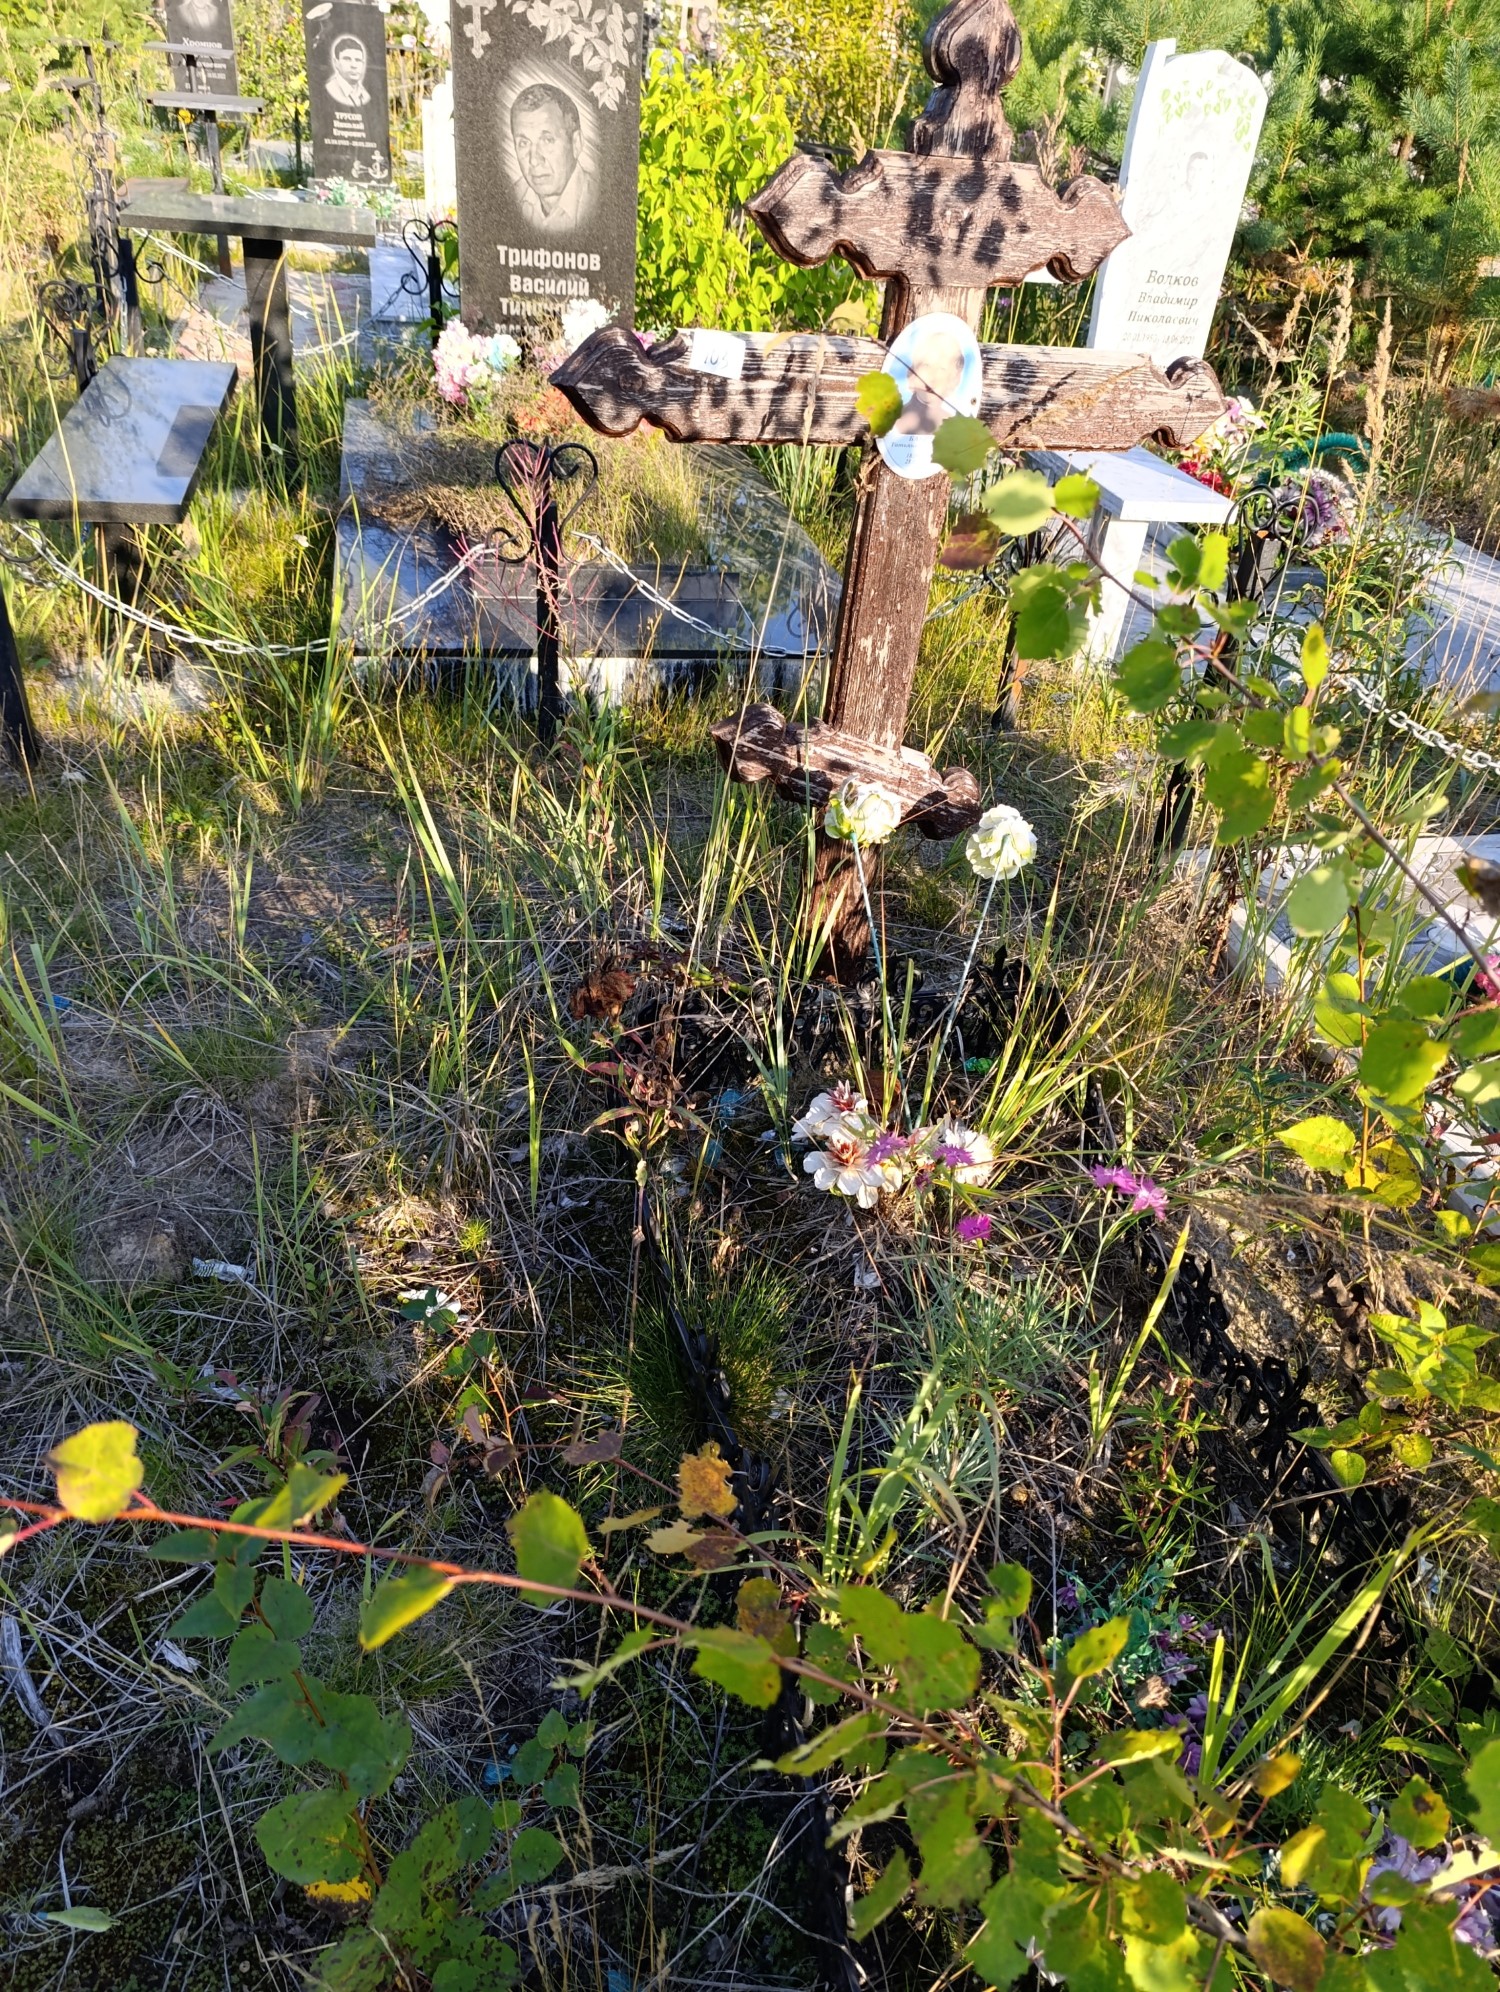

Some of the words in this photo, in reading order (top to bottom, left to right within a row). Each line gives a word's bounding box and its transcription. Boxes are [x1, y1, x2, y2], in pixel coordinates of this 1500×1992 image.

[496, 244, 602, 271] Трифонов
[509, 273, 590, 297] Василий
[1145, 269, 1199, 287] Волков
[1137, 291, 1199, 310] Владимир
